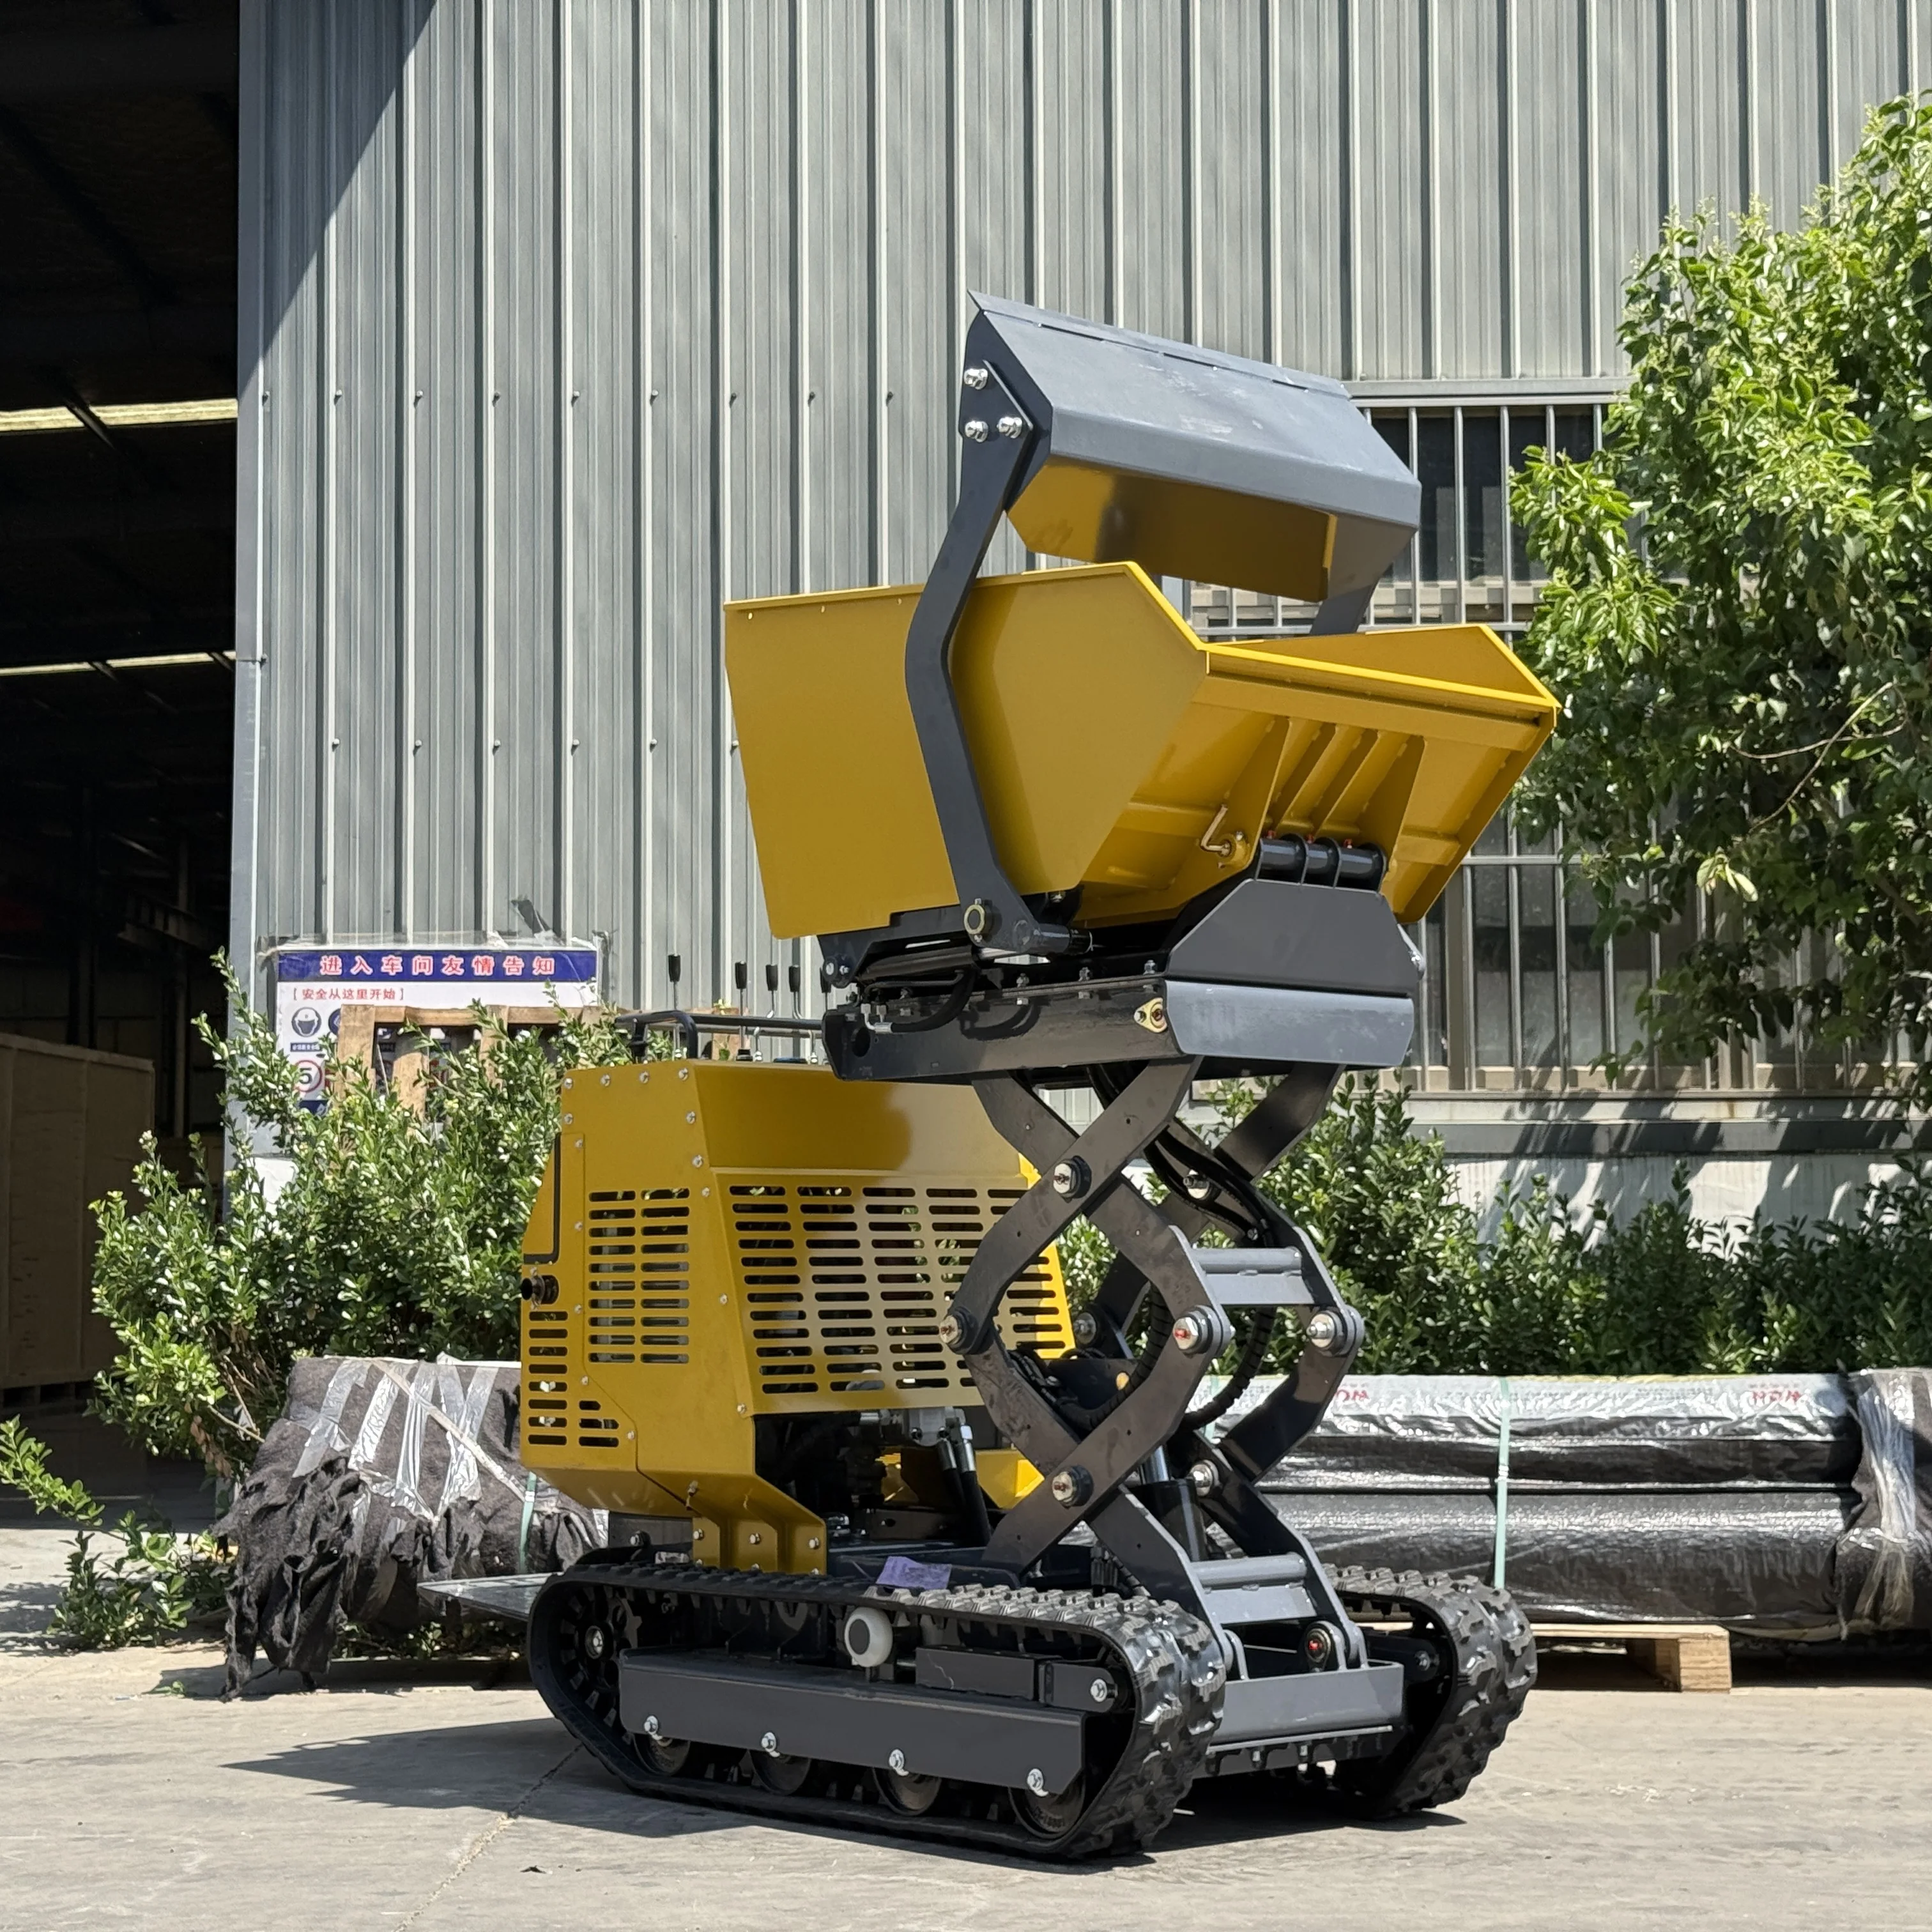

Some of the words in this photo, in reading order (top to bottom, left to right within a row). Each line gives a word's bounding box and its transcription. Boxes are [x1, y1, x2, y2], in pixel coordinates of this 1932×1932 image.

[321, 956, 555, 976] 进入车间友情告知
[298, 1067, 312, 1084] 5
